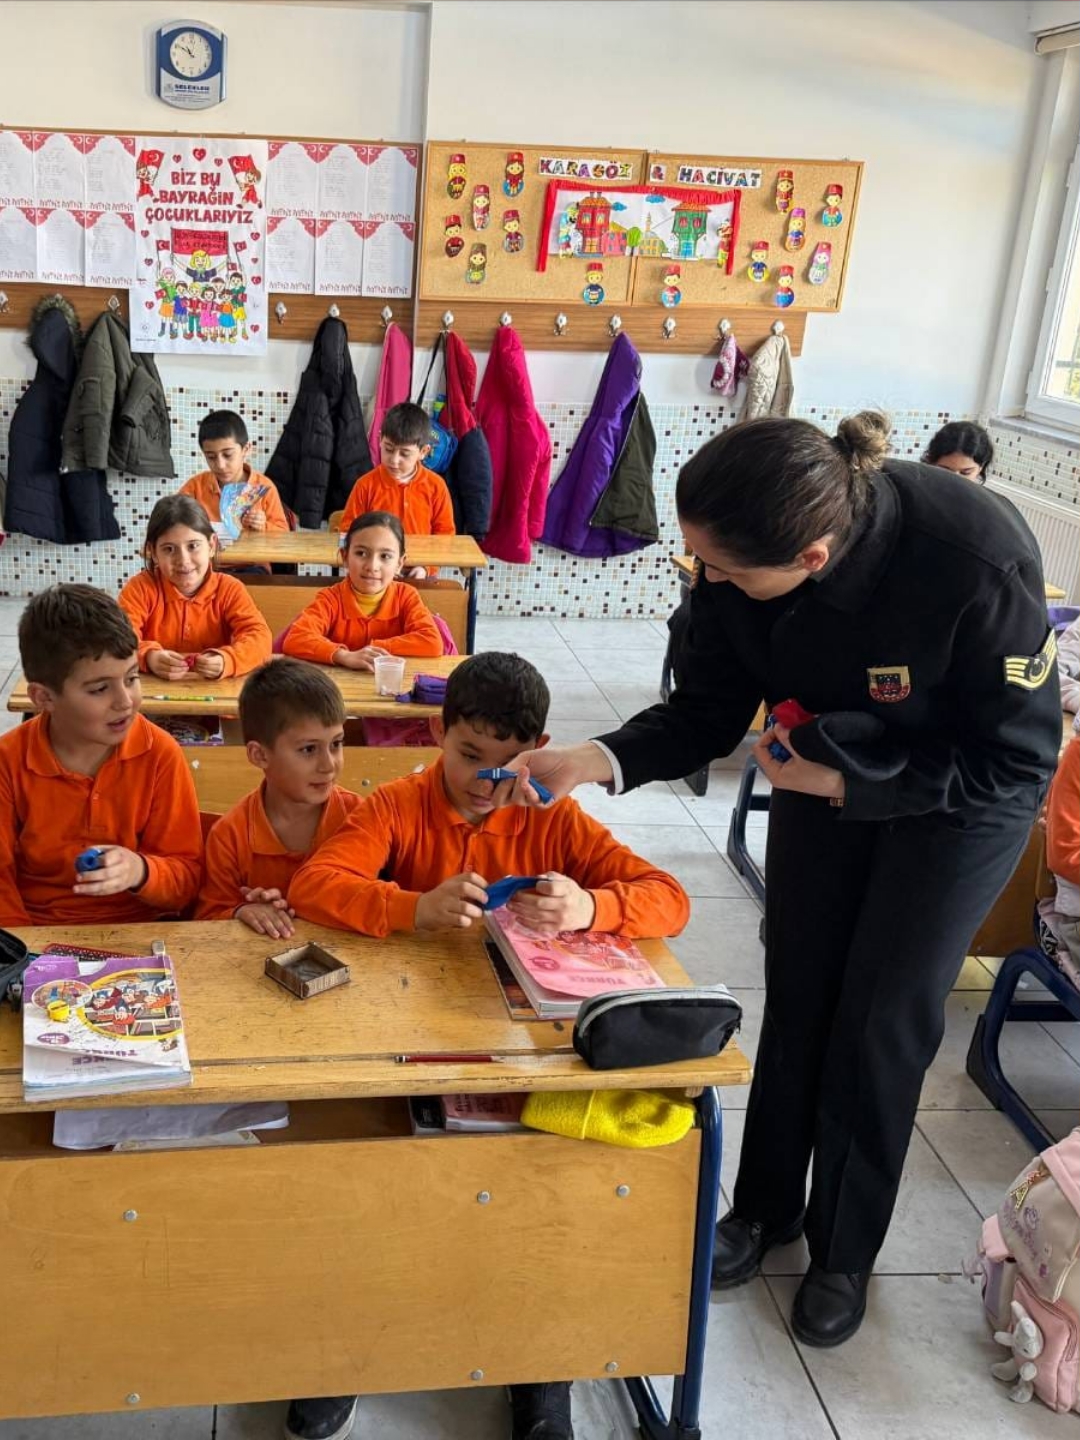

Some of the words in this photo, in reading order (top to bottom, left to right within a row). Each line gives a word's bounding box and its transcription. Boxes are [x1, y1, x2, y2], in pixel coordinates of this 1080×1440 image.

[170, 167, 196, 186] BİZ
[200, 172, 221, 187] BU
[539, 157, 632, 180] KARAGÖZ
[651, 165, 665, 181] &
[679, 166, 761, 188] HACİVAT
